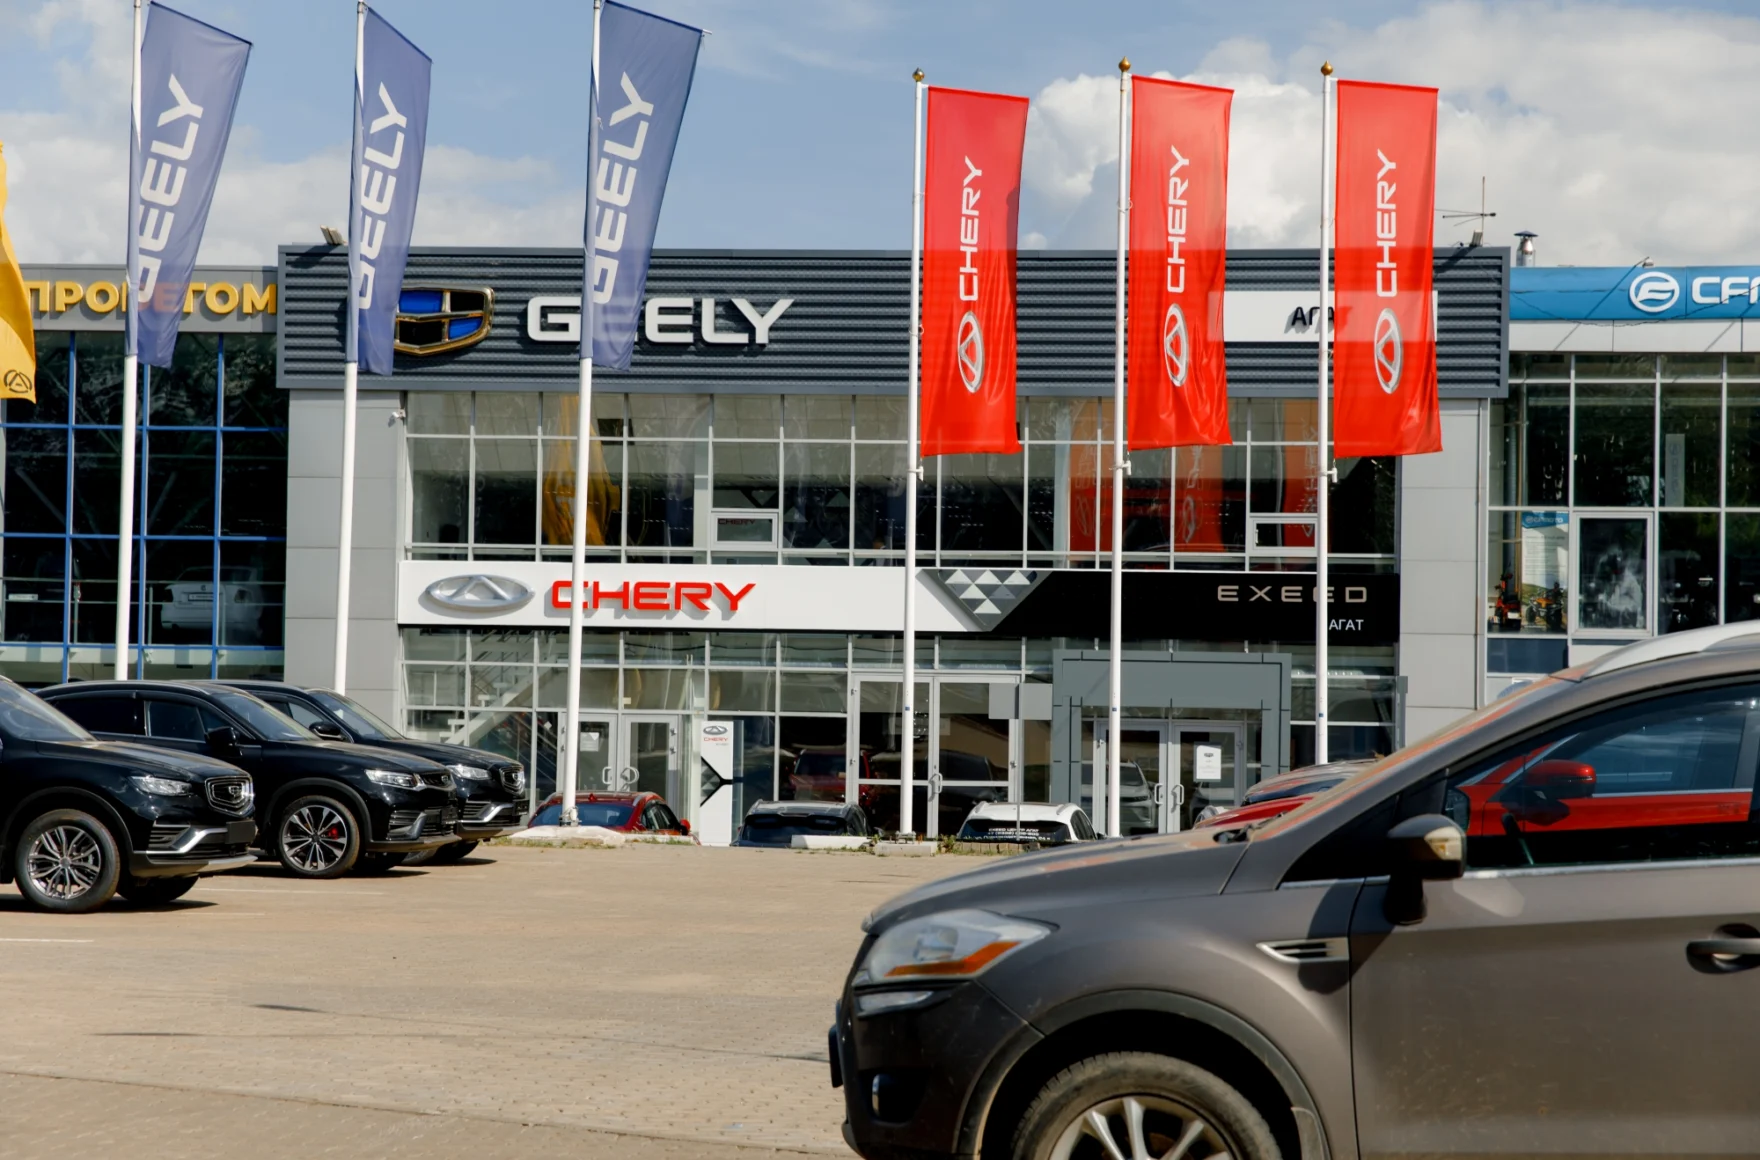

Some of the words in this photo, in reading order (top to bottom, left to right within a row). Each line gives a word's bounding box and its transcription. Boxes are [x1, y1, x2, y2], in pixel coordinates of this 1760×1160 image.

[958, 155, 983, 302] CHERY
[1166, 144, 1190, 294] CHERY
[1377, 148, 1397, 298] CHERY
[1691, 276, 1760, 304] CF
[551, 580, 757, 611] CHERY
[1217, 585, 1367, 603] EXEED
[1328, 618, 1365, 631] АГАТ
